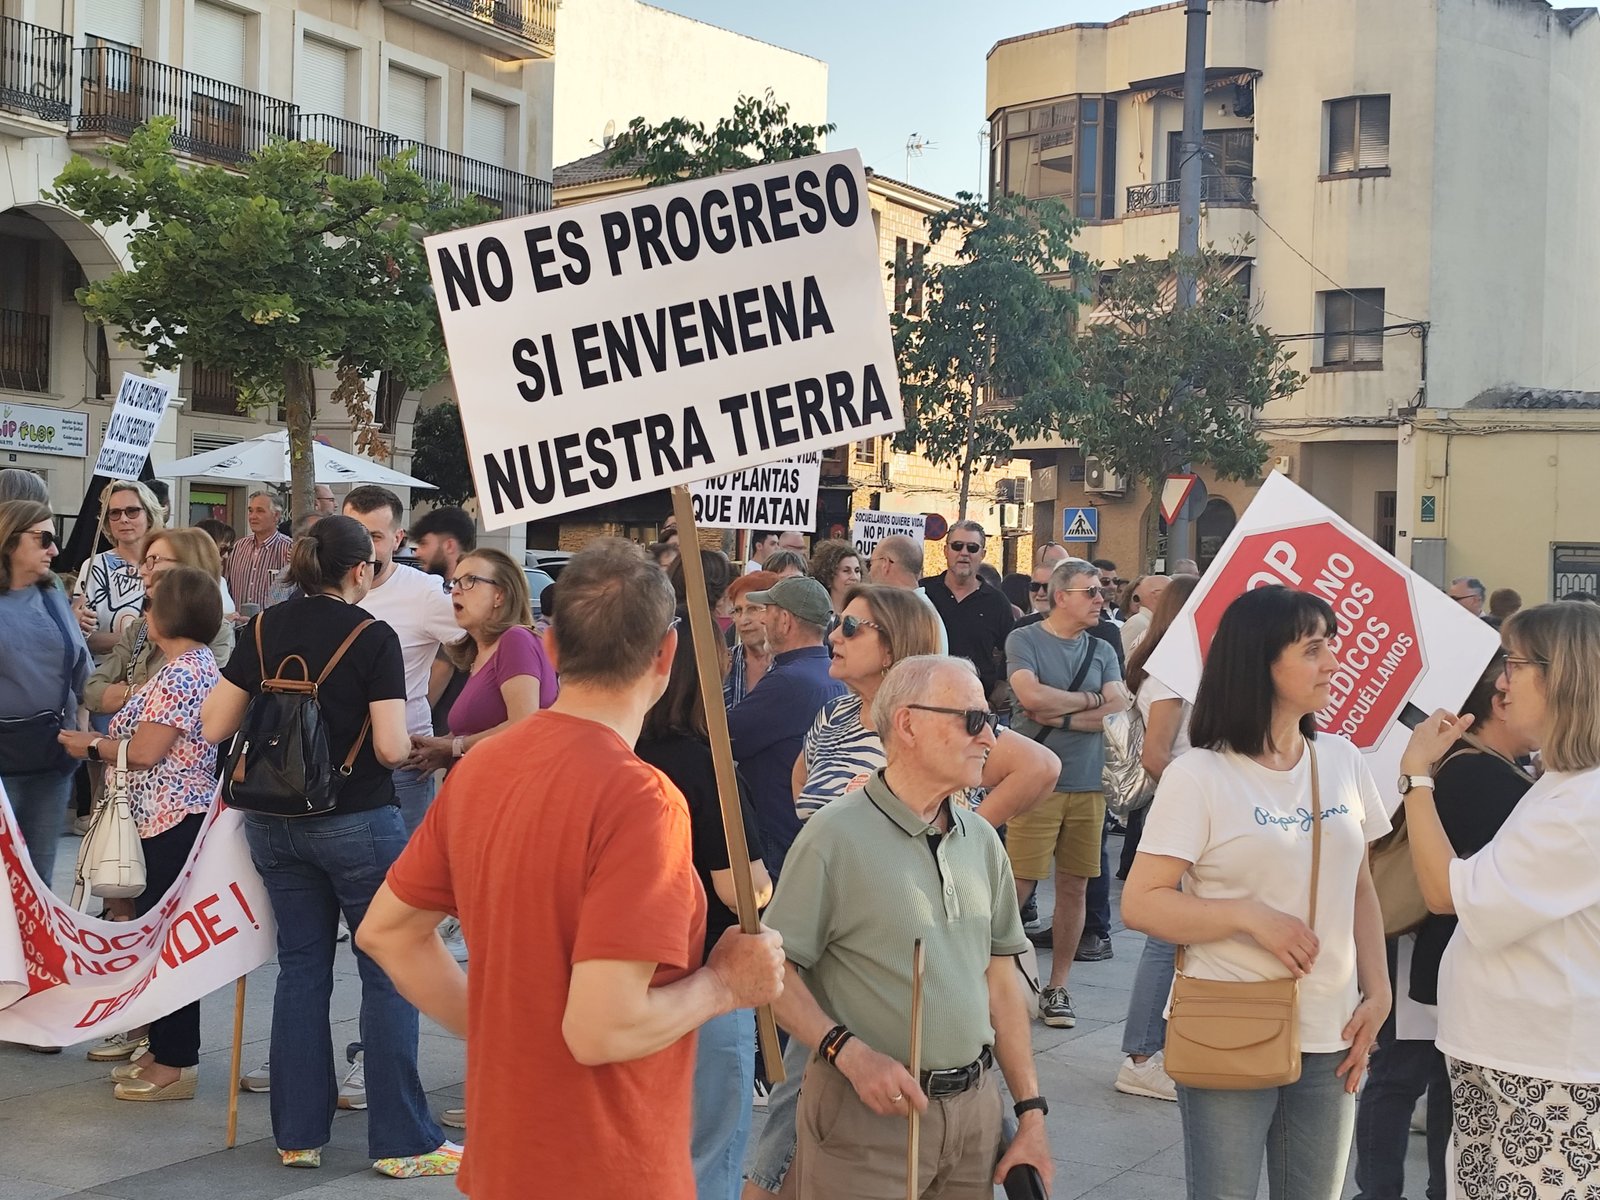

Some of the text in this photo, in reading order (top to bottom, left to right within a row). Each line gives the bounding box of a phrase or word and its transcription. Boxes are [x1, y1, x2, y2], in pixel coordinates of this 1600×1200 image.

[438, 163, 859, 311] NO ES PROGRESO
[512, 275, 834, 402] SI ENVENENA
[483, 363, 893, 515] NUESTRA TIERRA
[706, 467, 799, 493] NO PLANTAS
[692, 494, 809, 526] QUE MATAN
[891, 516, 910, 526] QUIERE
[863, 525, 875, 539] NO
[1336, 632, 1413, 741] SOCUÉLLAMOS
[1254, 804, 1349, 832] Pepe Jns
[71, 950, 139, 976] NO
